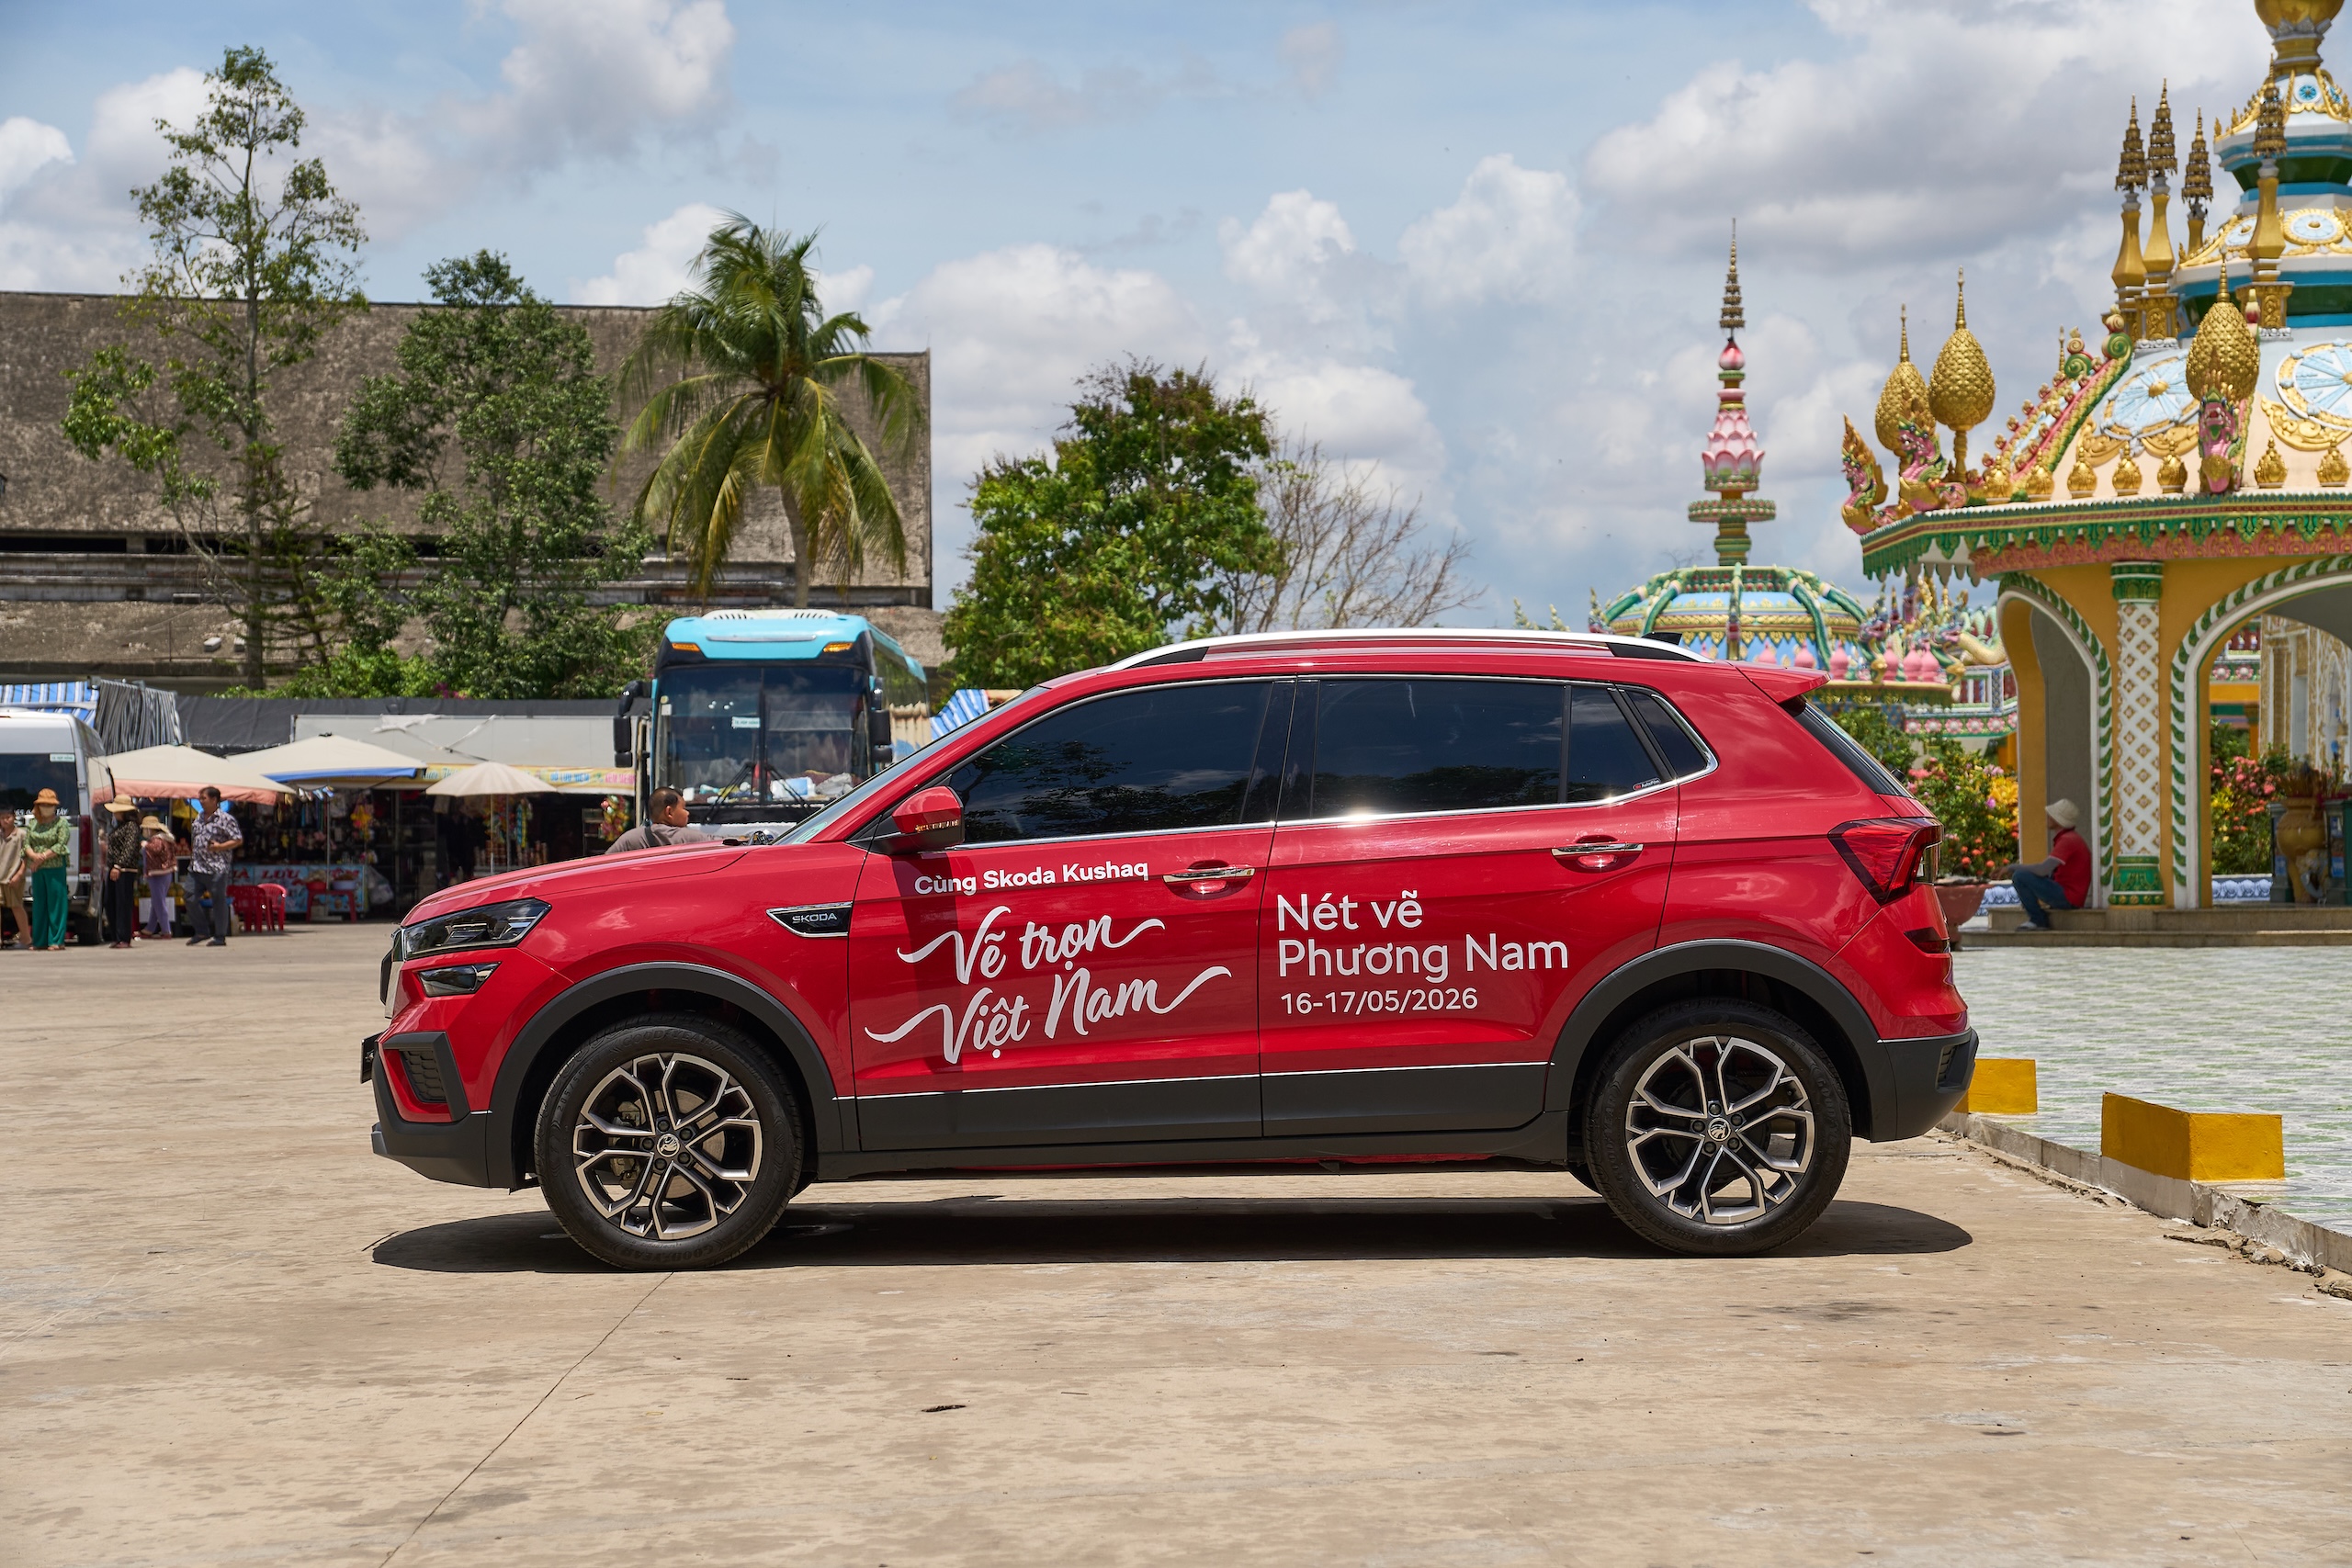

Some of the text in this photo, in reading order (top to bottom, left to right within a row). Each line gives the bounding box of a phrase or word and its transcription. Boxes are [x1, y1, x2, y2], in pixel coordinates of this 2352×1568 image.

[914, 861, 1149, 897] Cùng Skoda Kushaq
[792, 913, 837, 924] SKODA
[1277, 890, 1423, 931] Nét vẽ
[897, 906, 1166, 985] Vẽ trọn
[1278, 932, 1568, 984] Phương Nam
[865, 966, 1232, 1065] Việt Nam
[1281, 987, 1478, 1015] 16-17/05/2026
